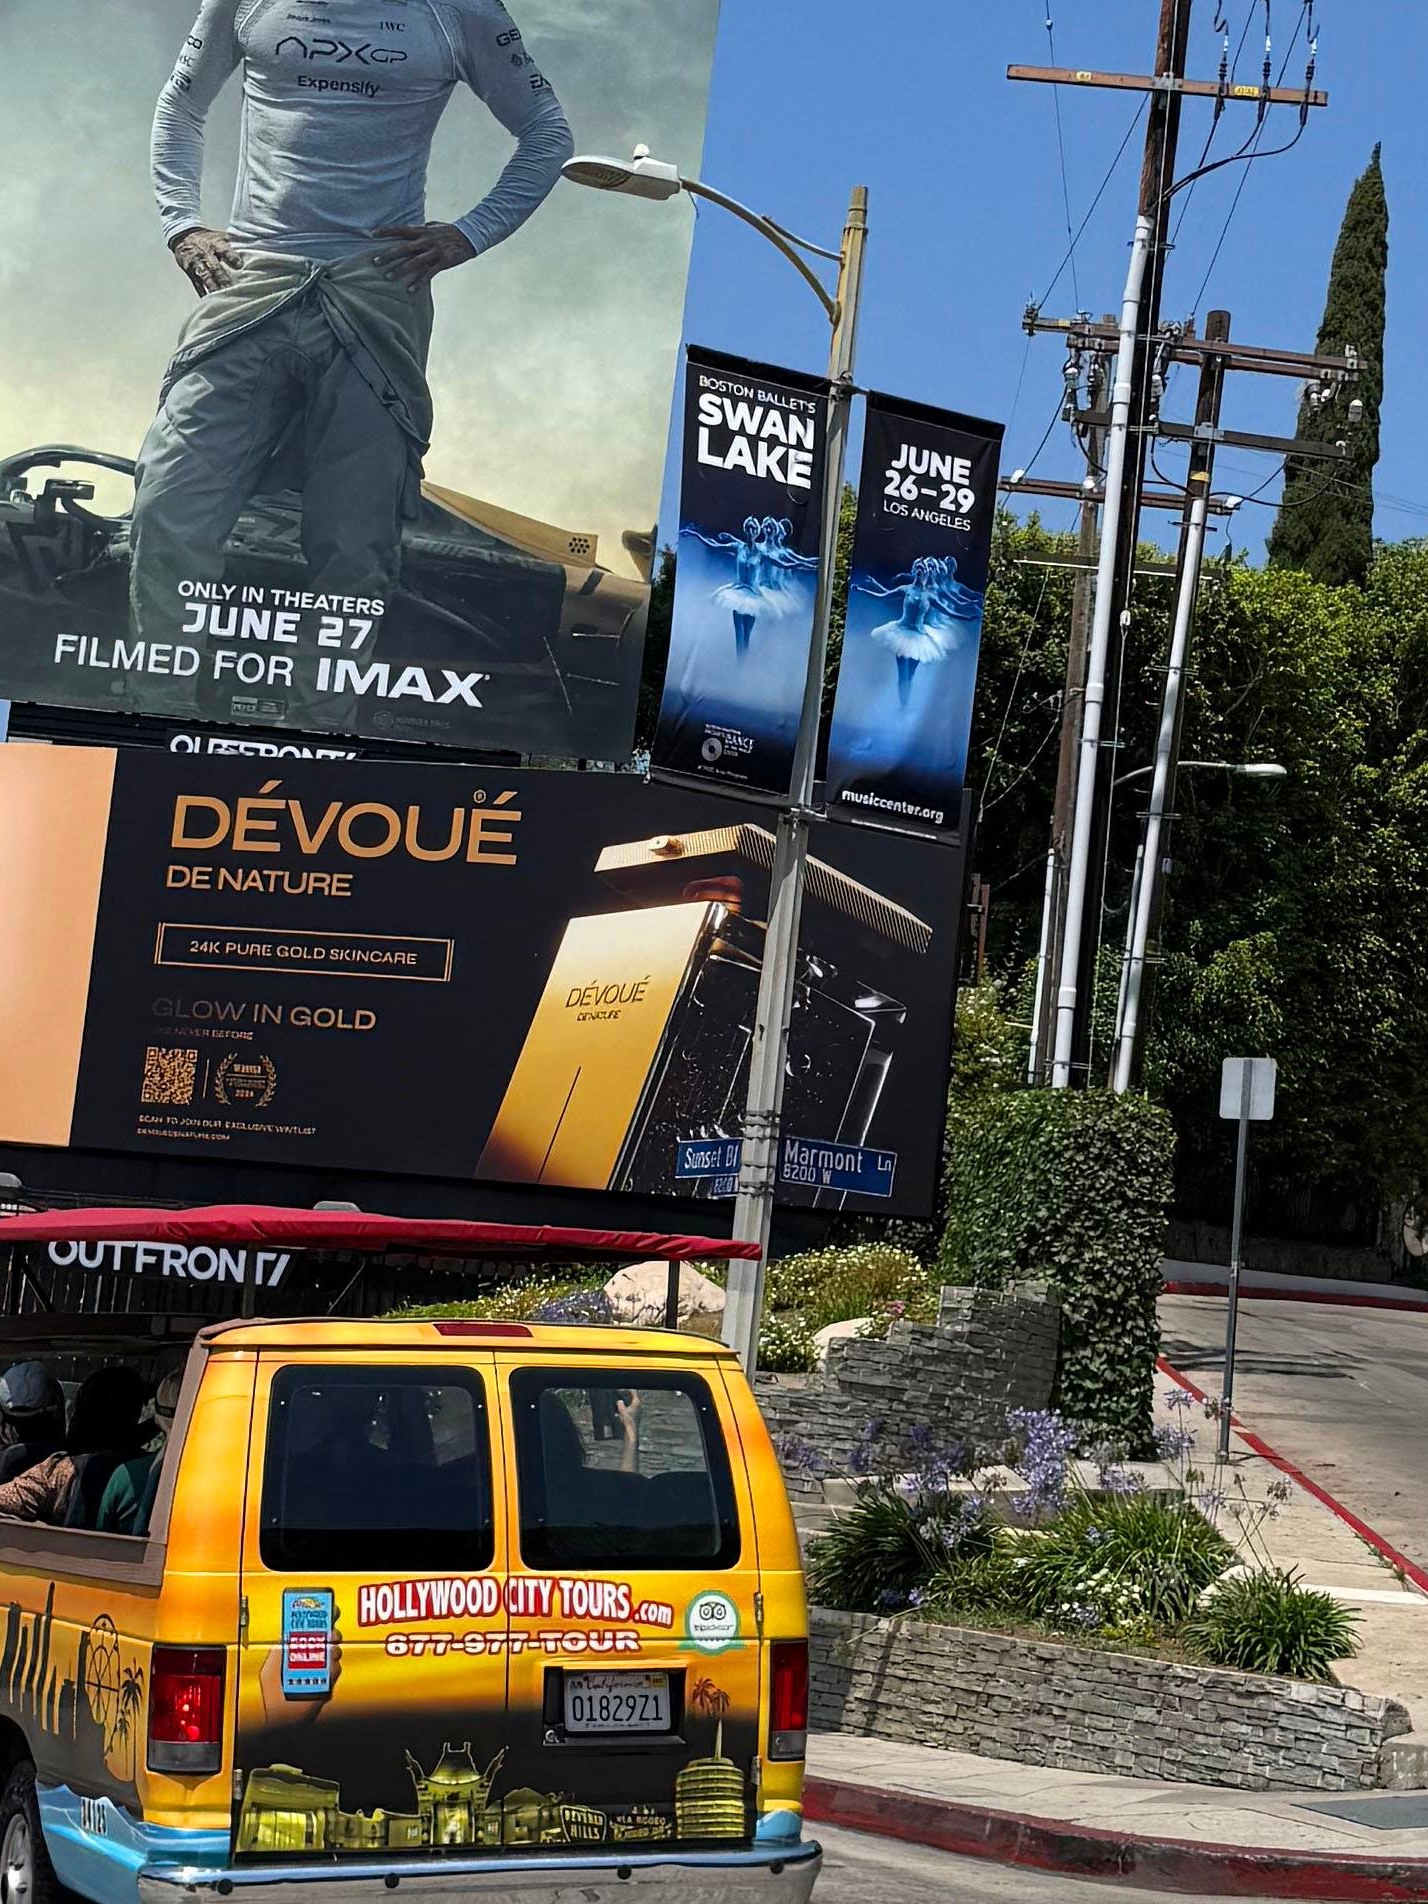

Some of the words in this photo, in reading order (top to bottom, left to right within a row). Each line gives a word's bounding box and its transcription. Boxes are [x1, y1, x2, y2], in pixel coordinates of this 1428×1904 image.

[297, 75, 381, 98] Expensify
[699, 375, 754, 398] BOSTON
[757, 390, 816, 414] BALLET'S
[698, 393, 815, 450] SWAN
[698, 426, 813, 489] LAKE
[891, 444, 971, 486] JUNE
[883, 499, 909, 516] LOS
[911, 508, 971, 531] ANGELES
[178, 580, 237, 601] ONLY
[242, 587, 264, 603] IN
[270, 589, 386, 616] THEATERS
[182, 602, 300, 643] JUNE
[318, 617, 373, 650] 27
[54, 633, 200, 676] FILMED
[213, 650, 294, 686] FOR
[316, 657, 486, 708] IMAX
[171, 779, 522, 865] DÉVOUÉ
[841, 789, 944, 824] musiccenter.org
[166, 865, 213, 889] DE
[217, 867, 354, 896] NATURE
[189, 940, 220, 954] 24K
[225, 942, 272, 957] PURE
[276, 945, 326, 960] GOLD
[329, 948, 417, 965] SKINCARE
[566, 975, 651, 1008] DÉVOUÉ
[152, 996, 246, 1022] GLOW
[253, 1003, 284, 1024] IN
[290, 1006, 377, 1030] GOLD
[685, 1143, 722, 1169] Sunset
[785, 1139, 864, 1173] Marmont
[877, 1156, 892, 1171] Ln
[783, 1164, 816, 1183] 8200
[822, 1168, 832, 1185] W
[359, 1578, 500, 1627] HOLLYWOOD
[505, 1577, 556, 1616] CITY
[560, 1579, 631, 1622] TOURS
[573, 1694, 663, 1722] 01829Z1
[570, 1826, 600, 1840] HILLS
